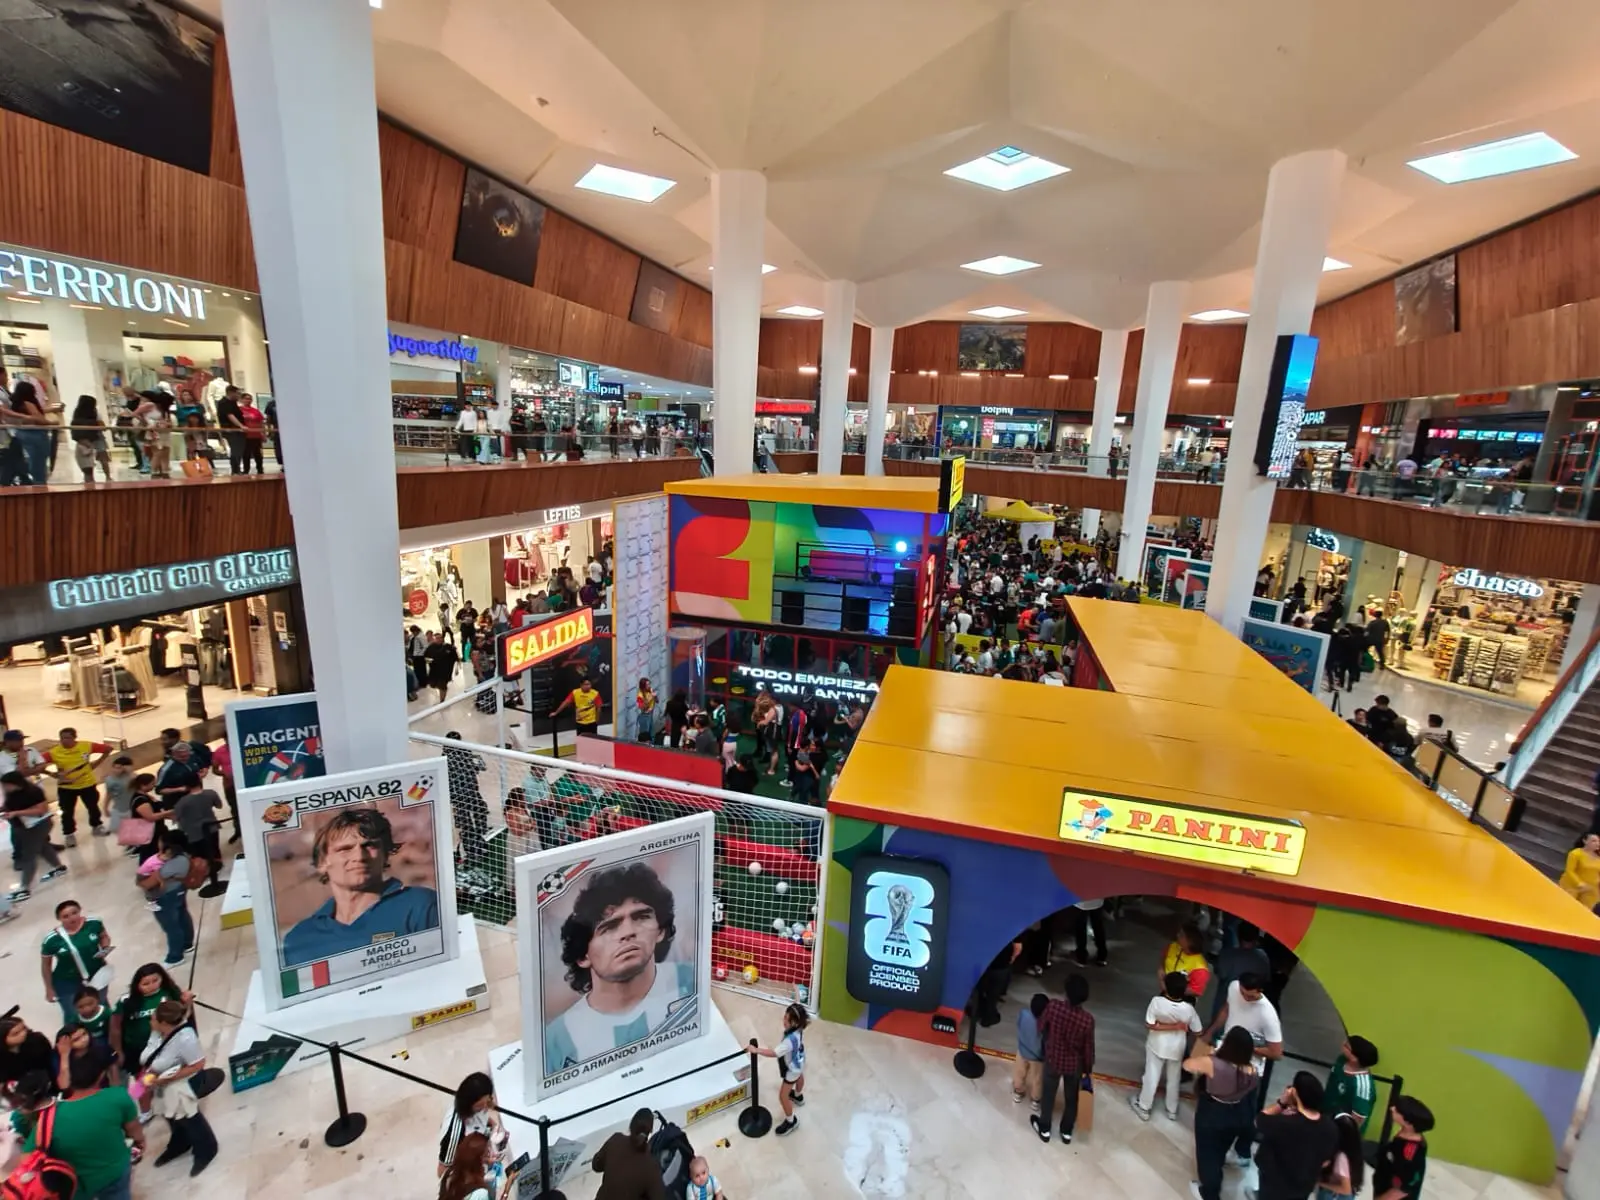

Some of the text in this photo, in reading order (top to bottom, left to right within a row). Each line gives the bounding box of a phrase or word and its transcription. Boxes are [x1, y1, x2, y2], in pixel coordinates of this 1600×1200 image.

[0, 251, 206, 320] FERRIONI
[50, 568, 164, 610] Cuidado
[168, 563, 211, 591] con
[214, 552, 242, 582] el
[1453, 568, 1543, 598] shasa
[510, 615, 590, 667] SALIDA
[738, 665, 881, 693] TODO EMPIEZA
[244, 745, 279, 757] WORLD
[245, 757, 264, 766] CUP
[293, 779, 403, 811] ESPAÑA 82
[639, 831, 700, 852] ARGENTINA
[1127, 810, 1293, 854] PANINI
[360, 945, 417, 968] TARDELLI
[366, 938, 410, 957] MARCO
[882, 944, 912, 959] FIFA
[869, 971, 920, 986] LICENSED
[871, 964, 919, 978] OFFICIAL
[869, 978, 920, 993] PRODUCT
[938, 1024, 955, 1032] FIFA
[543, 1022, 698, 1089] DIEGO ARMANDO MARADONA
